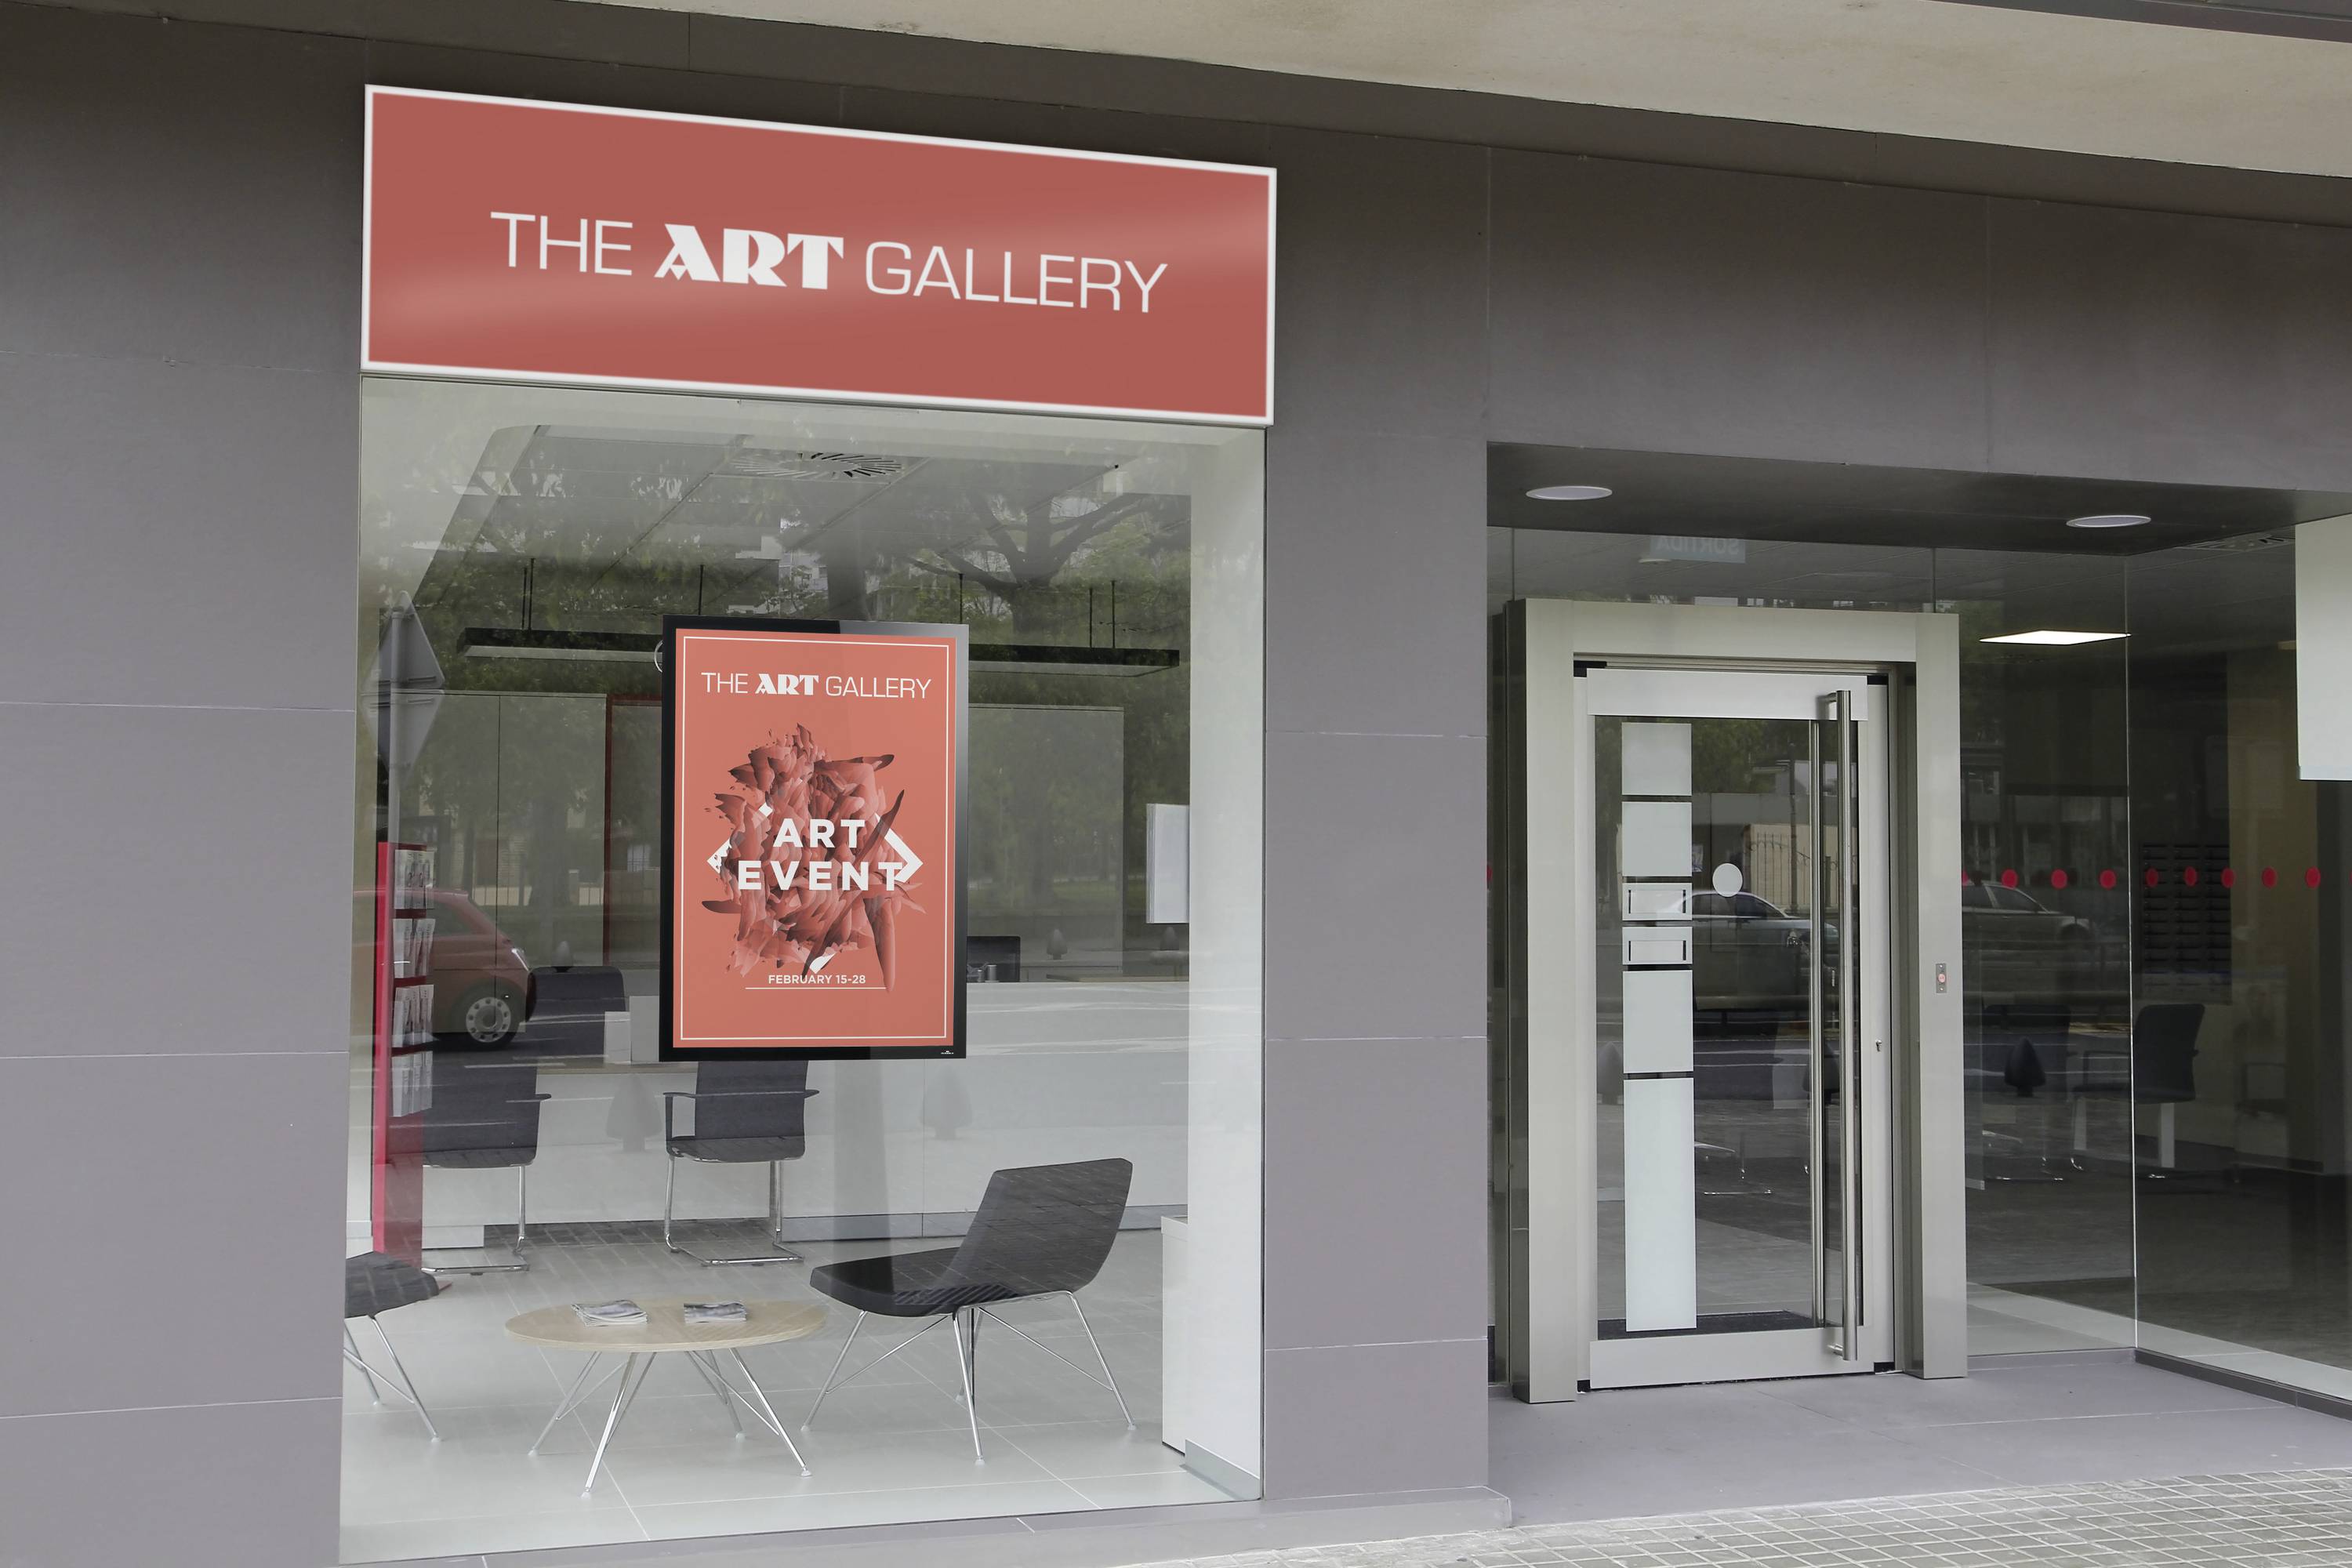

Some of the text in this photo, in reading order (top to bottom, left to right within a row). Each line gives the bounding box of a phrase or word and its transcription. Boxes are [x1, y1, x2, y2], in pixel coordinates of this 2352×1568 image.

[490, 212, 1168, 313] THE ART GALLERY
[701, 672, 932, 699] THE ART GALLERY
[772, 818, 866, 848] ART
[738, 860, 903, 891] EVENT
[768, 975, 866, 984] FEBRUARY 15-28
